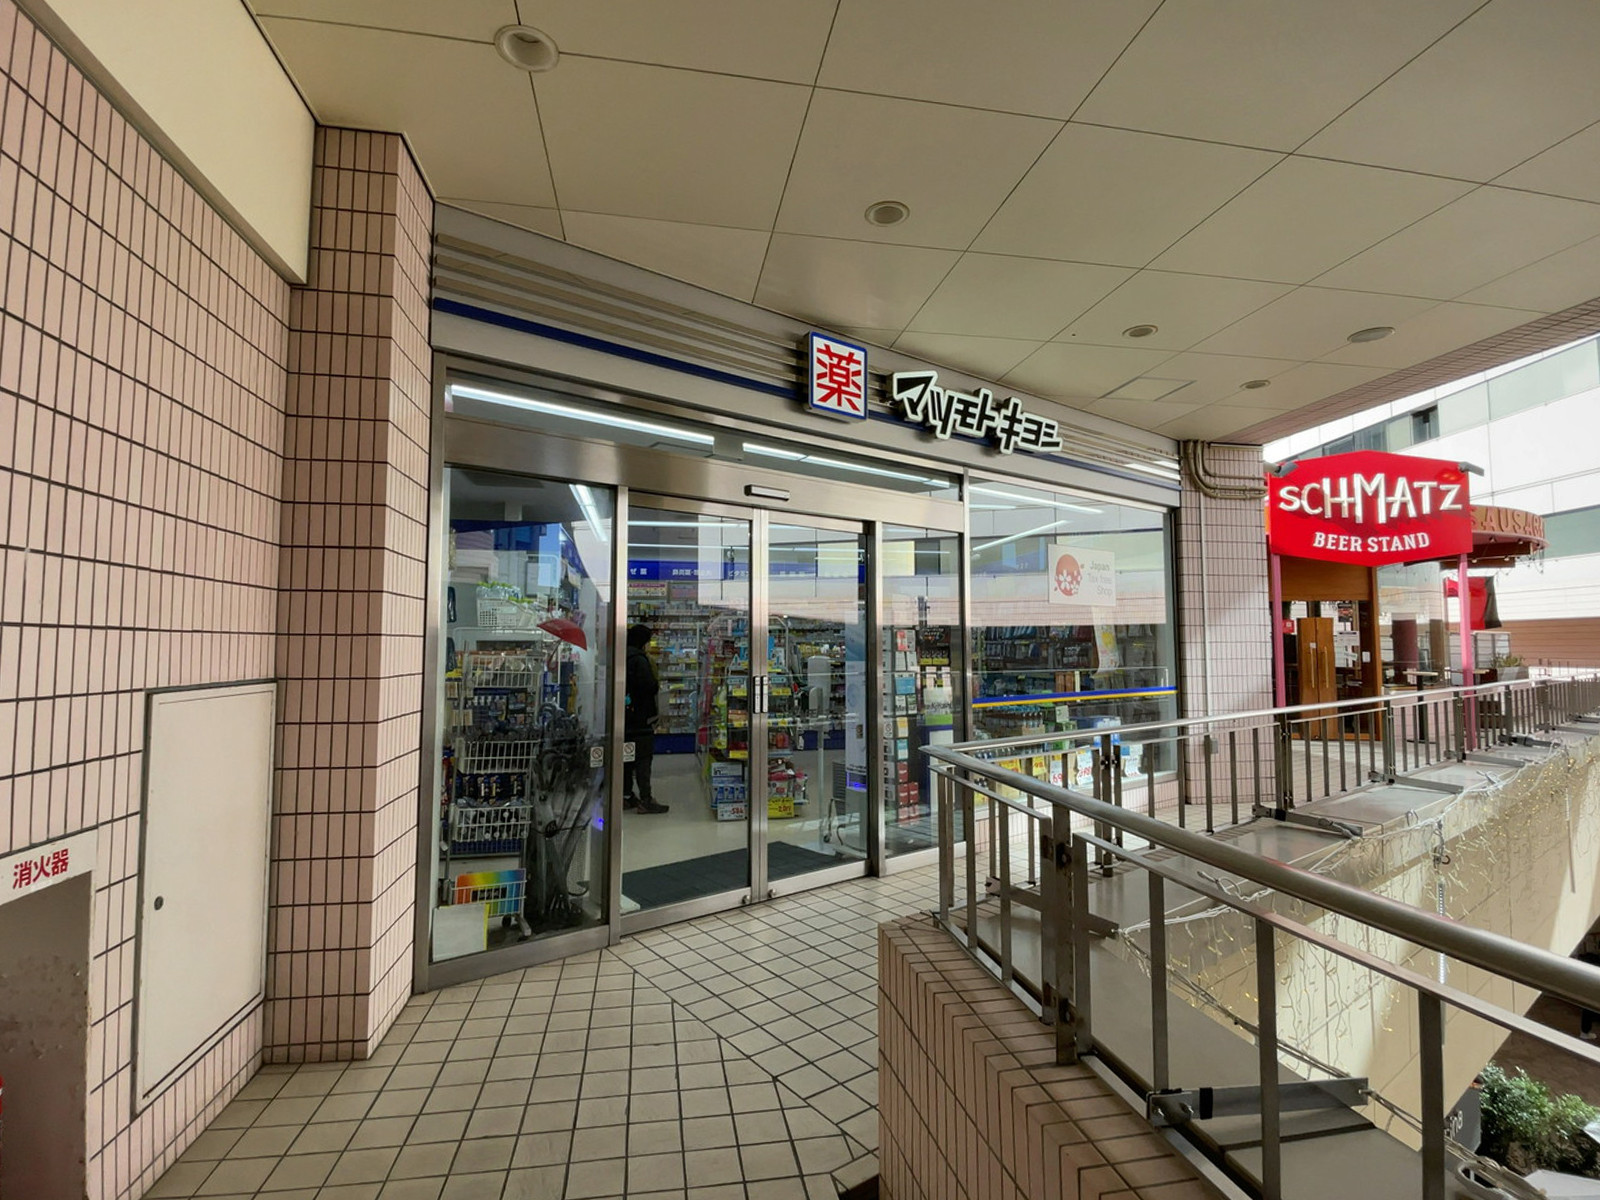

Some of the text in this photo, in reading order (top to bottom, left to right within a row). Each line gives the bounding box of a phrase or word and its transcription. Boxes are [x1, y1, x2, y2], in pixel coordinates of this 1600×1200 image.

[816, 343, 862, 412] 薬
[1278, 472, 1463, 524] SCHMATZ
[1312, 531, 1431, 553] BEER STAND
[12, 848, 69, 890] 消火器
